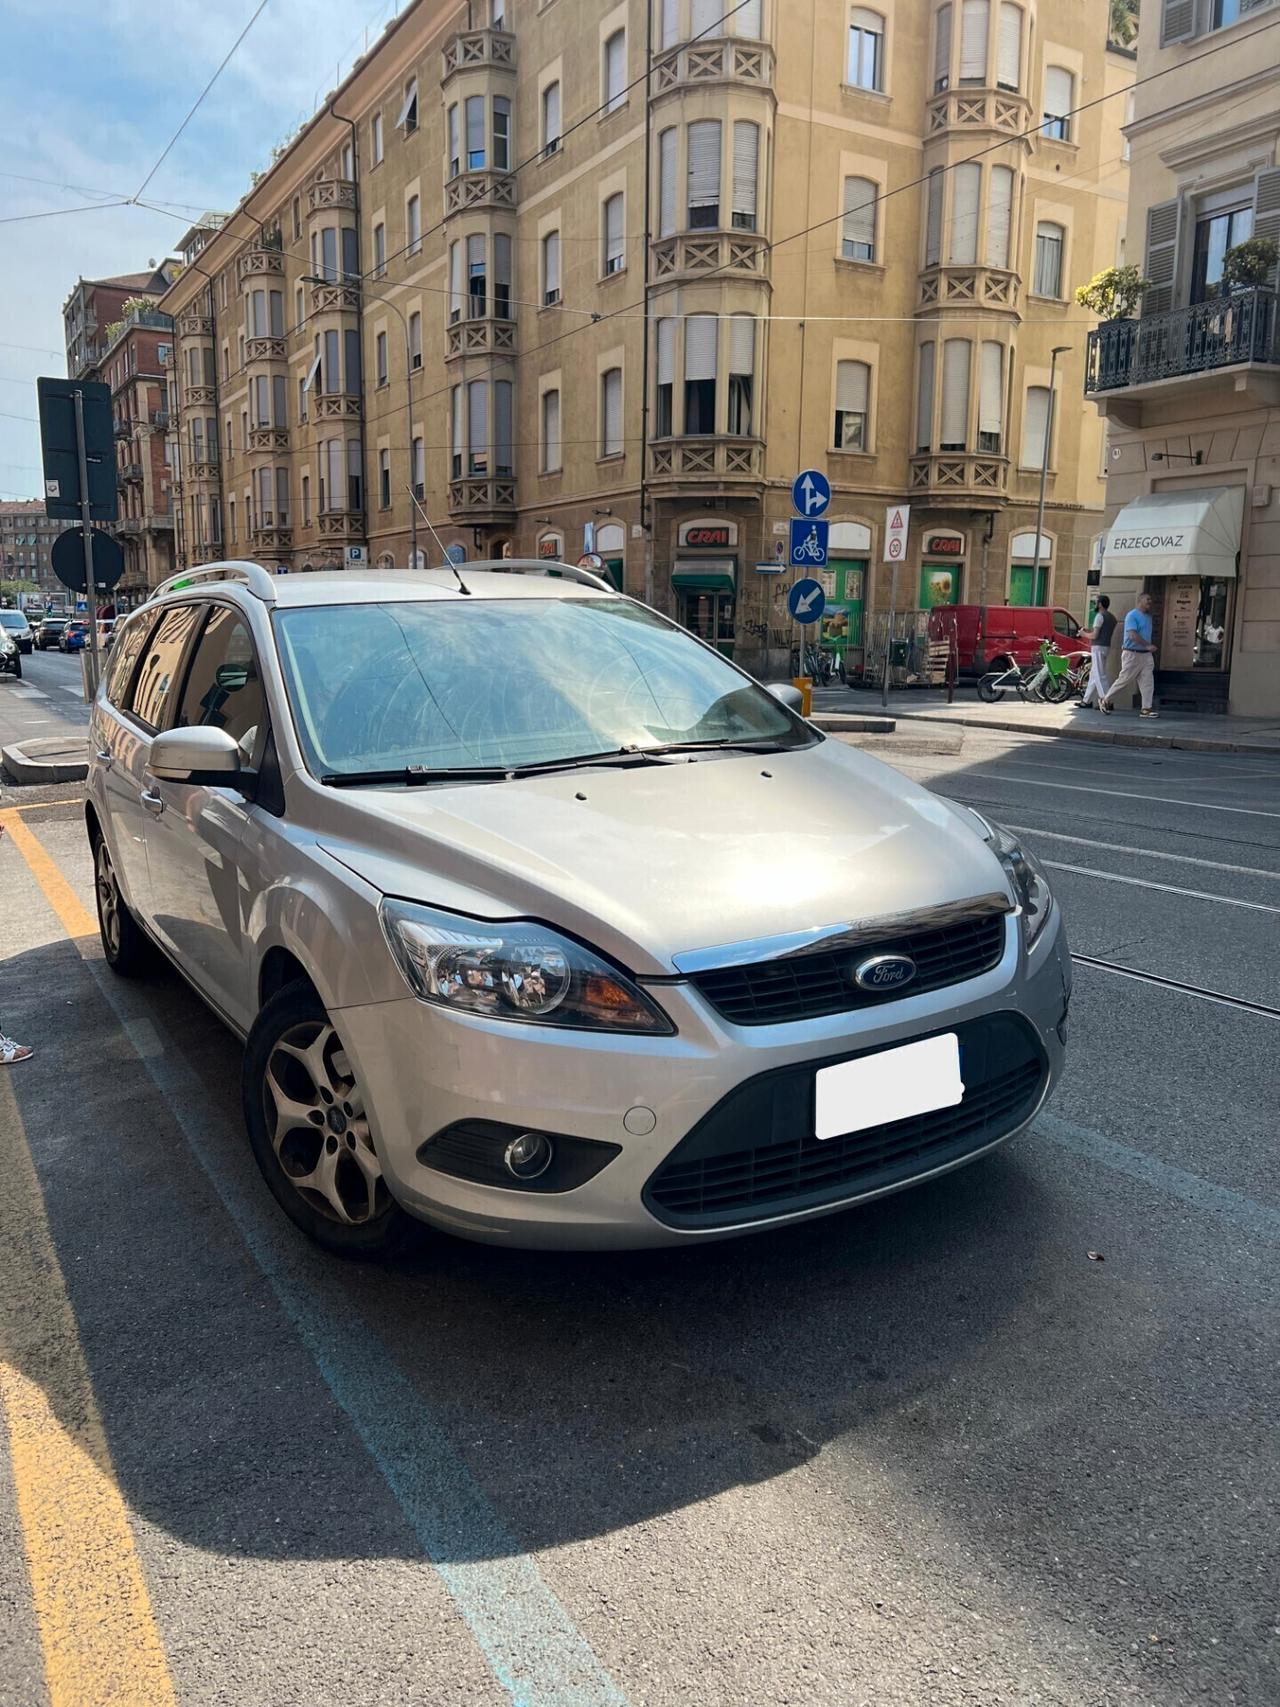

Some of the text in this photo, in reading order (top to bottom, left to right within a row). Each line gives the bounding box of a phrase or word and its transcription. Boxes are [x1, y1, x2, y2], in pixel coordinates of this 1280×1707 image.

[688, 530, 727, 544] CRAI
[1113, 535, 1184, 549] ERZEGOVAZ
[351, 549, 359, 558] P
[873, 963, 904, 984] Ford
